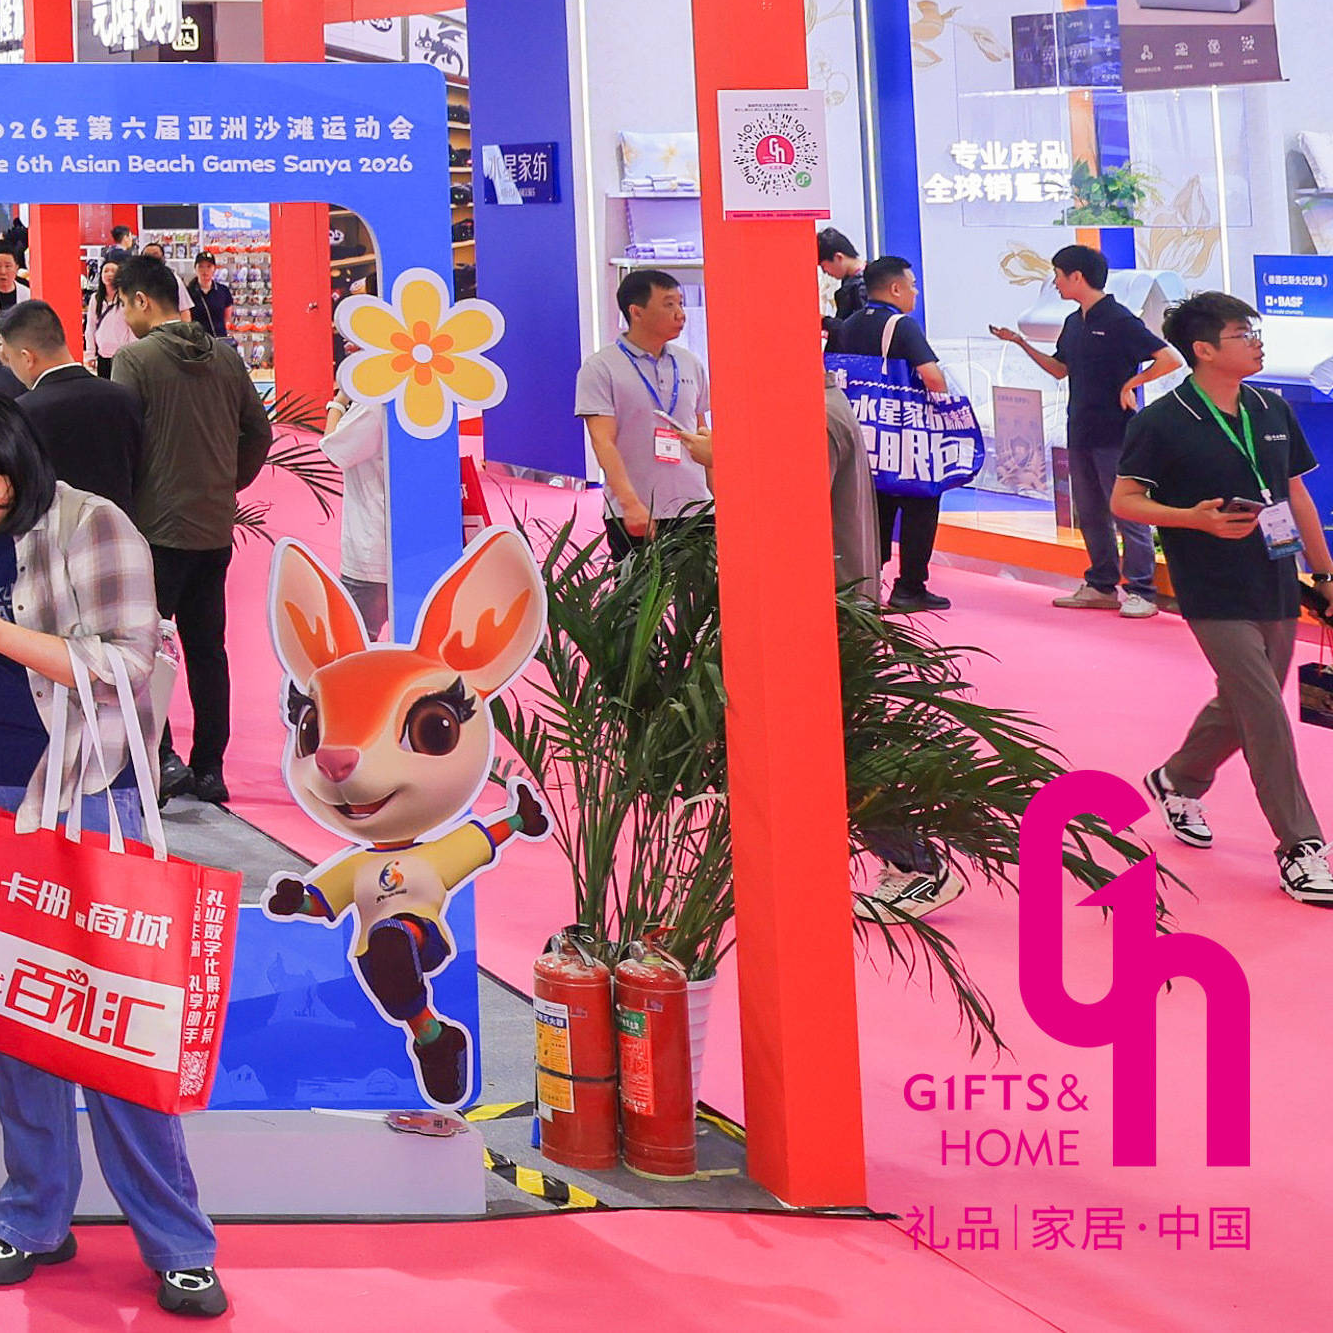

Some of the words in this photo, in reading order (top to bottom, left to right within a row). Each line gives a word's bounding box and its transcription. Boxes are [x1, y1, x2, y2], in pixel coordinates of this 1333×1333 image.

[16, 154, 53, 173] 6th
[60, 154, 120, 173] Asian
[128, 154, 194, 173] Beach
[203, 154, 276, 173] Games
[283, 154, 351, 175] Sanya
[359, 154, 413, 173] 2026
[950, 139, 1070, 170] 专业床品
